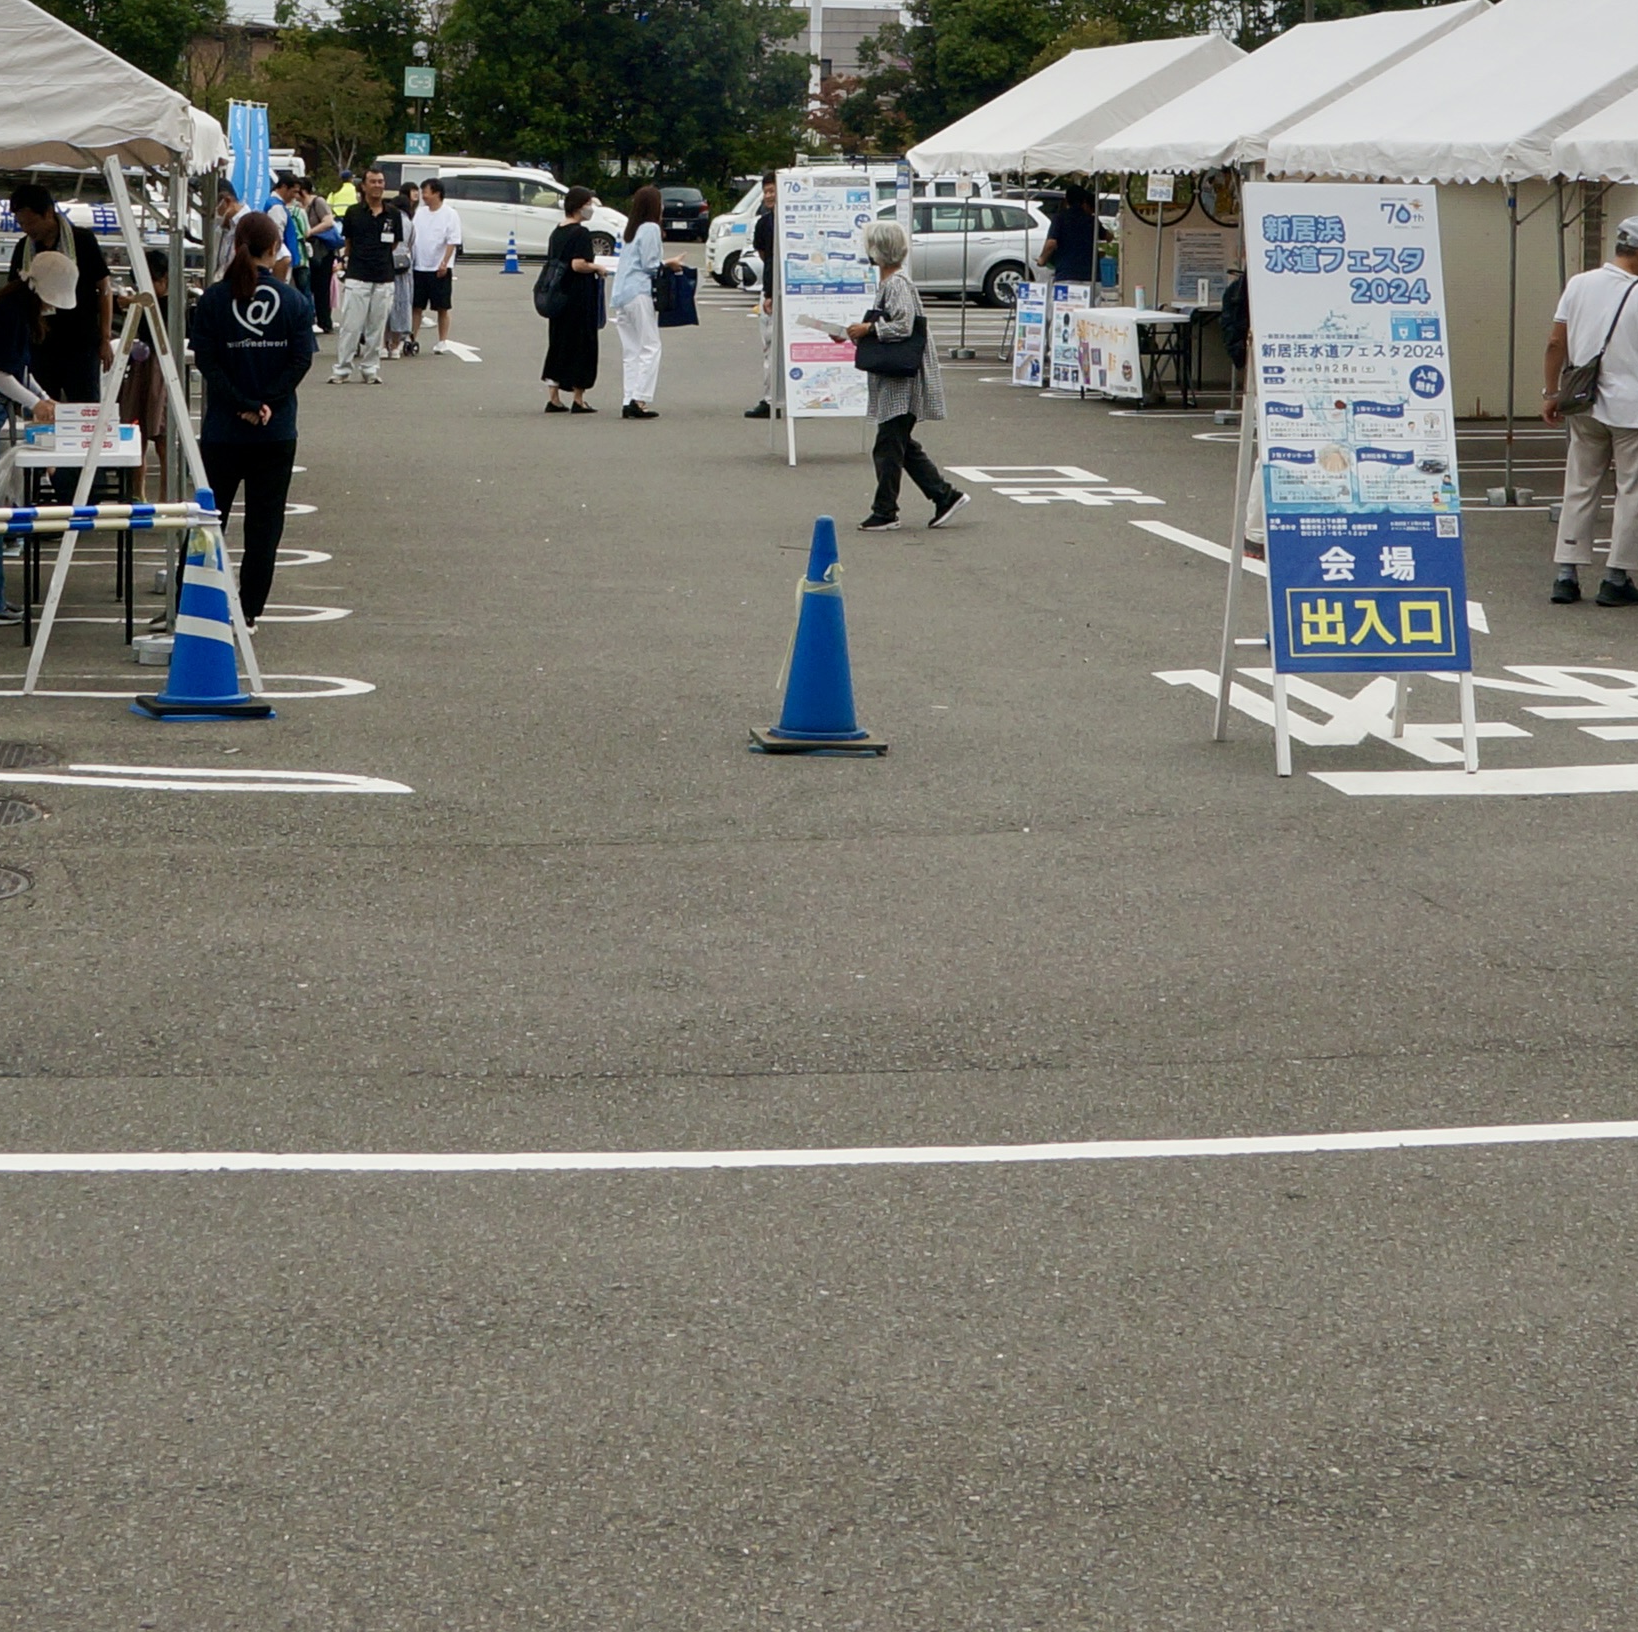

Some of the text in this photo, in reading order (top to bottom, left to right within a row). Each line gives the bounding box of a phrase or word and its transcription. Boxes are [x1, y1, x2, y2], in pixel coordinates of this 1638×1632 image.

[408, 74, 432, 89] C-3
[1262, 215, 1345, 243] 新居浜
[1265, 246, 1425, 273] 水道フェスタ
[1350, 278, 1430, 304] 2024
[1262, 343, 1444, 360] 新居浜水道フェスタ2024
[1416, 369, 1439, 382] 入場
[1318, 545, 1416, 582] 会場
[1300, 598, 1443, 646] 出入口
